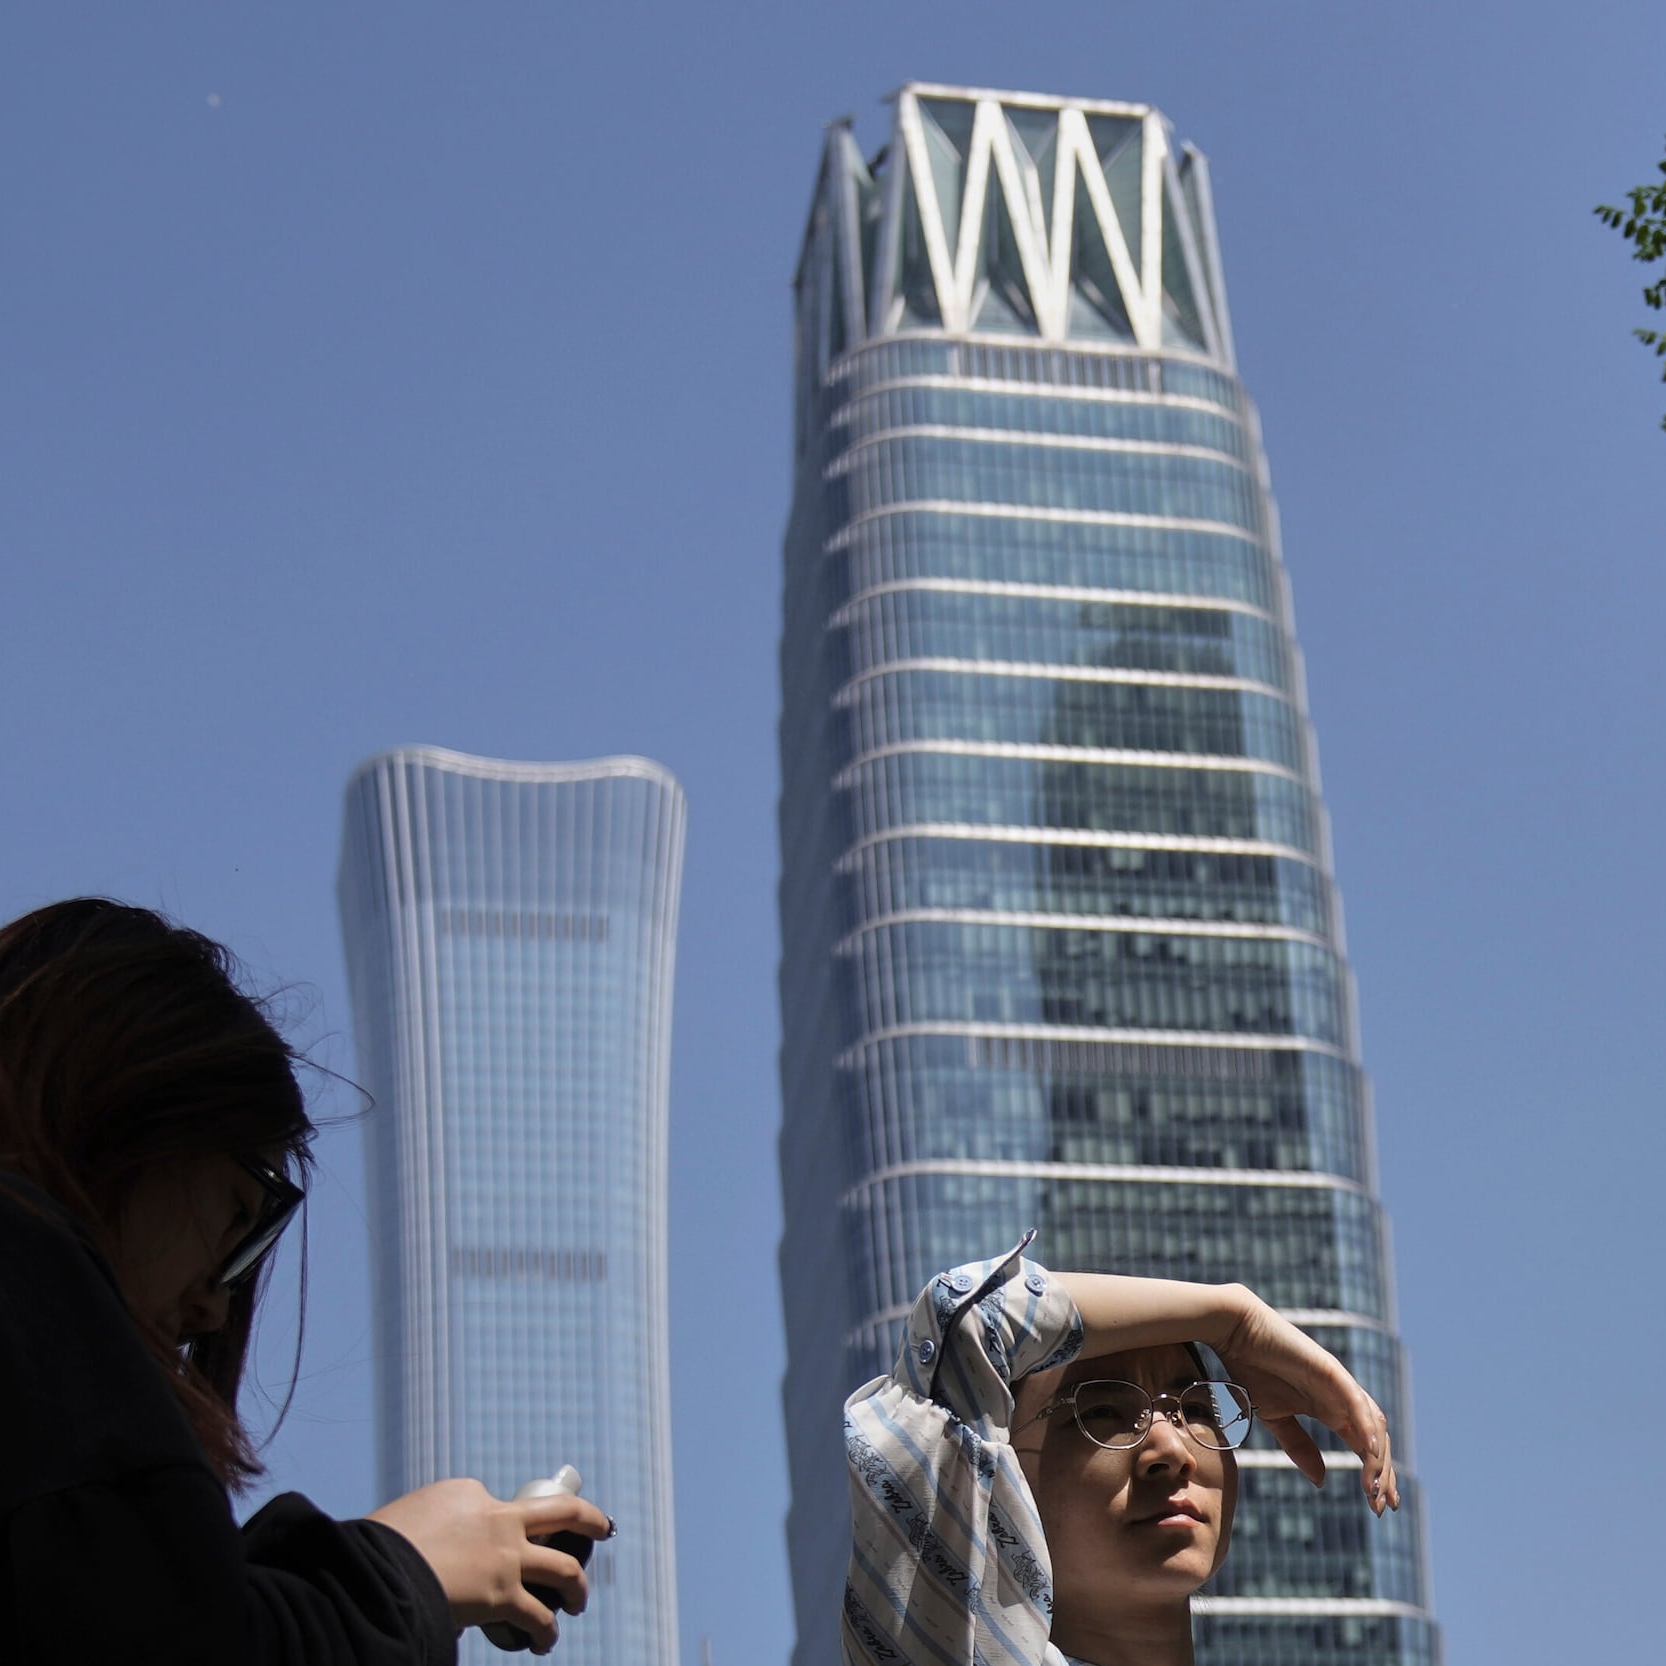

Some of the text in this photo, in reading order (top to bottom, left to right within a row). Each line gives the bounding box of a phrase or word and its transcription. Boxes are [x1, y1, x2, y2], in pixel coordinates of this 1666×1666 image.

[882, 1480, 912, 1514] Zebra
[935, 1554, 968, 1587] Zebra
[863, 1628, 898, 1661] Zebra
